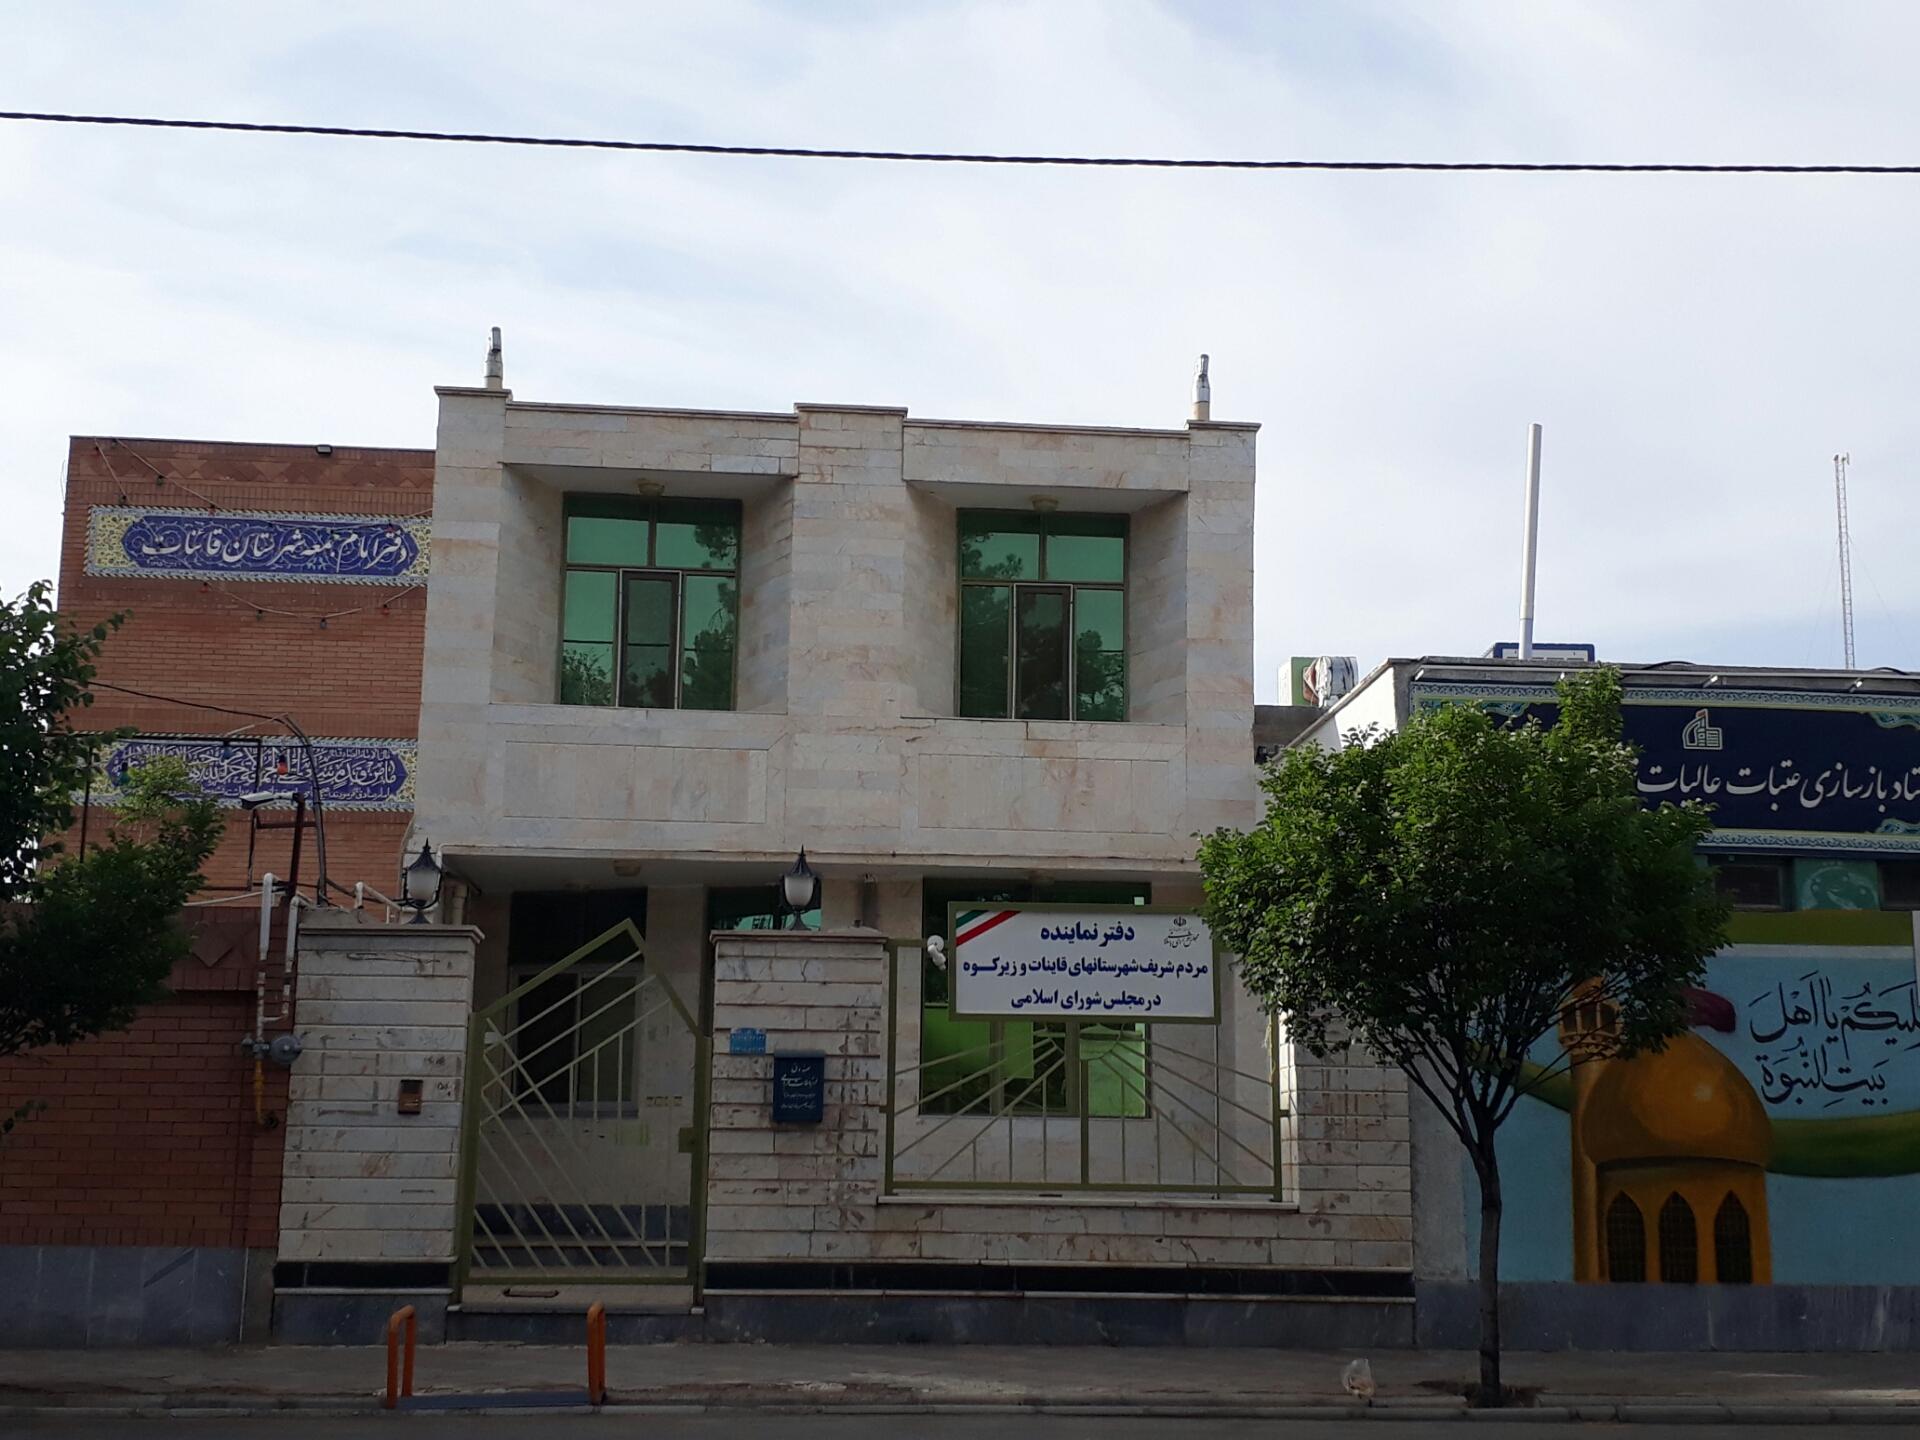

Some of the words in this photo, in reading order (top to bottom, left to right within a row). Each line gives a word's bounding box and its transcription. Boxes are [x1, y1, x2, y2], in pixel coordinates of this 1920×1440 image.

[221, 528, 306, 567] شهرستان
[335, 532, 379, 573] امام
[364, 529, 407, 569] دفتر
[1636, 763, 1722, 808] عالیات
[1726, 758, 1801, 812] عتبات
[1890, 764, 1920, 802] تاد
[1040, 920, 1099, 942] نماینده
[1098, 923, 1136, 947] دفتر
[1020, 962, 1027, 976] و
[1028, 956, 1068, 976] قاینات
[1068, 957, 1139, 978] شهرستانهای
[1138, 957, 1175, 978] شریف
[1176, 961, 1209, 979] مردم
[1010, 988, 1060, 1009] اسلامی
[1060, 990, 1104, 1011] شورای
[1103, 990, 1144, 1010] مجلس
[1144, 992, 1162, 1012] در
